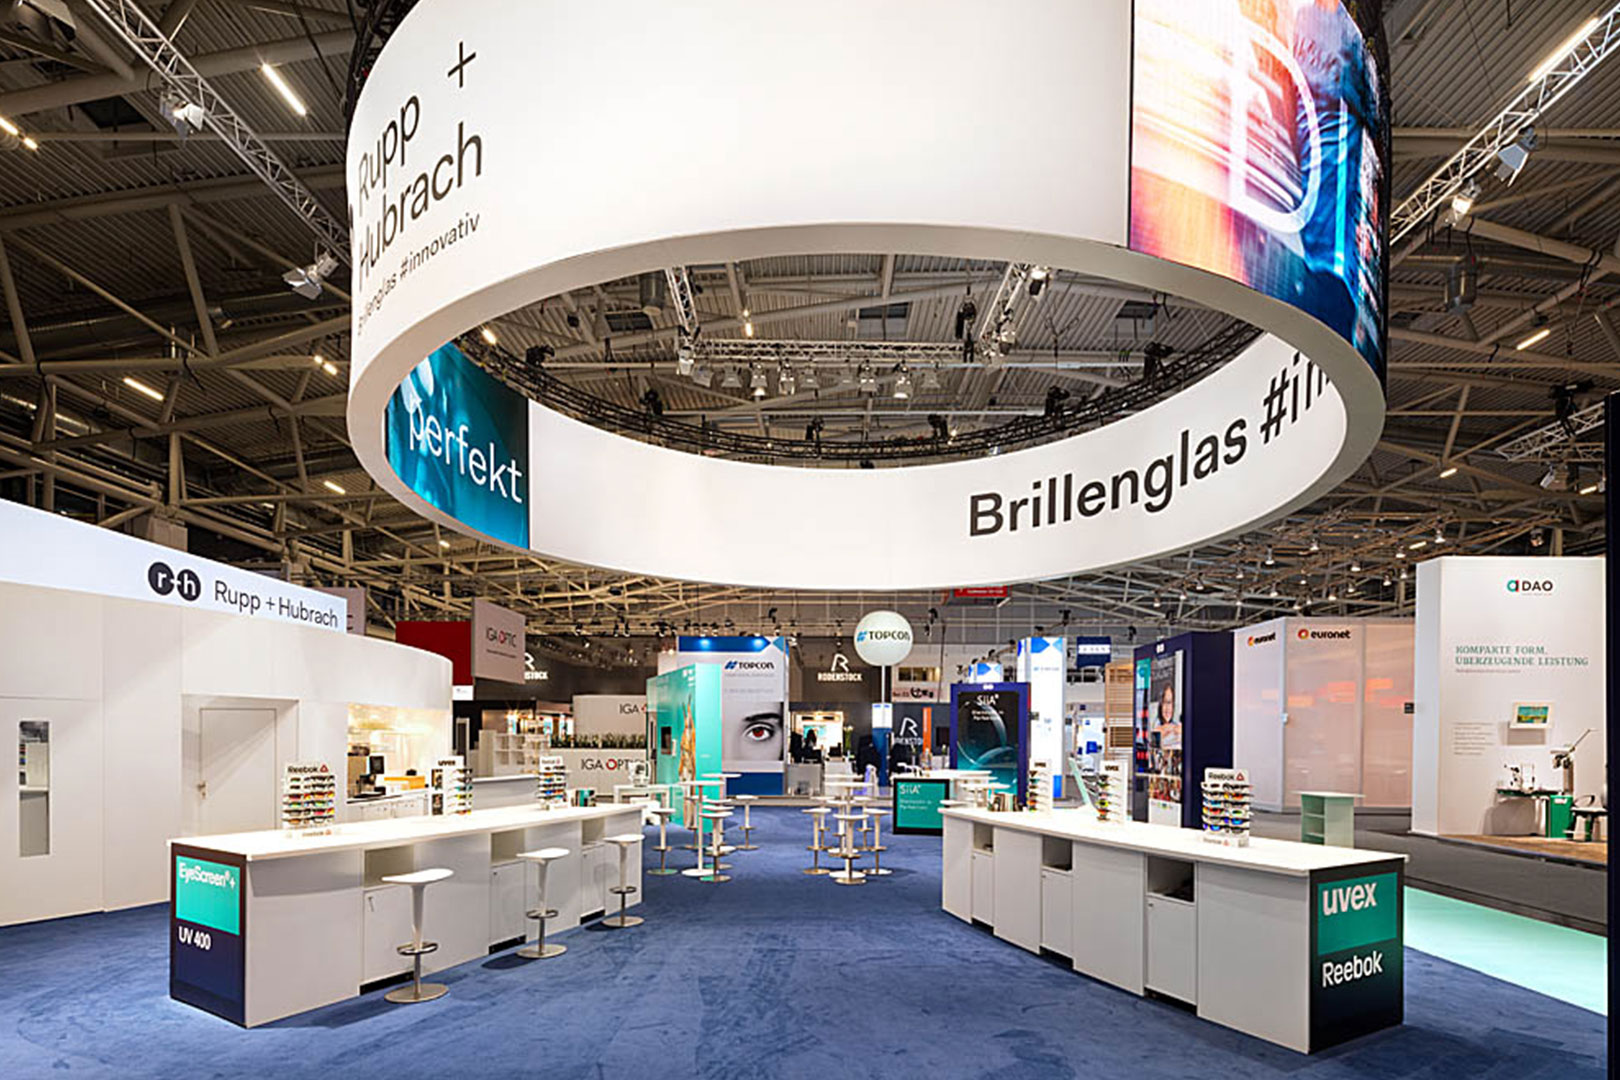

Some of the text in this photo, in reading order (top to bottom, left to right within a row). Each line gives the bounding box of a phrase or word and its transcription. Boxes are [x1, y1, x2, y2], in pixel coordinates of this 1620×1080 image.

[358, 94, 421, 217] Rupp
[359, 121, 483, 293] Hubrach
[400, 211, 481, 281] #innovativ
[409, 396, 523, 504] perfekt
[968, 350, 1330, 537] Brillenglas #in
[1521, 579, 1554, 592] DAO
[214, 580, 262, 615] Rupp
[278, 597, 339, 629] Hubrach
[868, 631, 911, 641] TOPCON
[1310, 630, 1352, 640] euronet
[1456, 645, 1513, 655] KOMPAKTE
[738, 661, 775, 670] TOPCON
[1455, 655, 1590, 667] ÜBERZEUGENDE LEISTUNG
[817, 672, 863, 682] RODENSTOCK
[619, 703, 640, 714] IGA
[580, 759, 604, 770] IGA
[1207, 772, 1236, 780] Reebok
[1322, 881, 1378, 916] uvex
[178, 925, 212, 951] UV 400
[1321, 950, 1383, 988] Reebok
